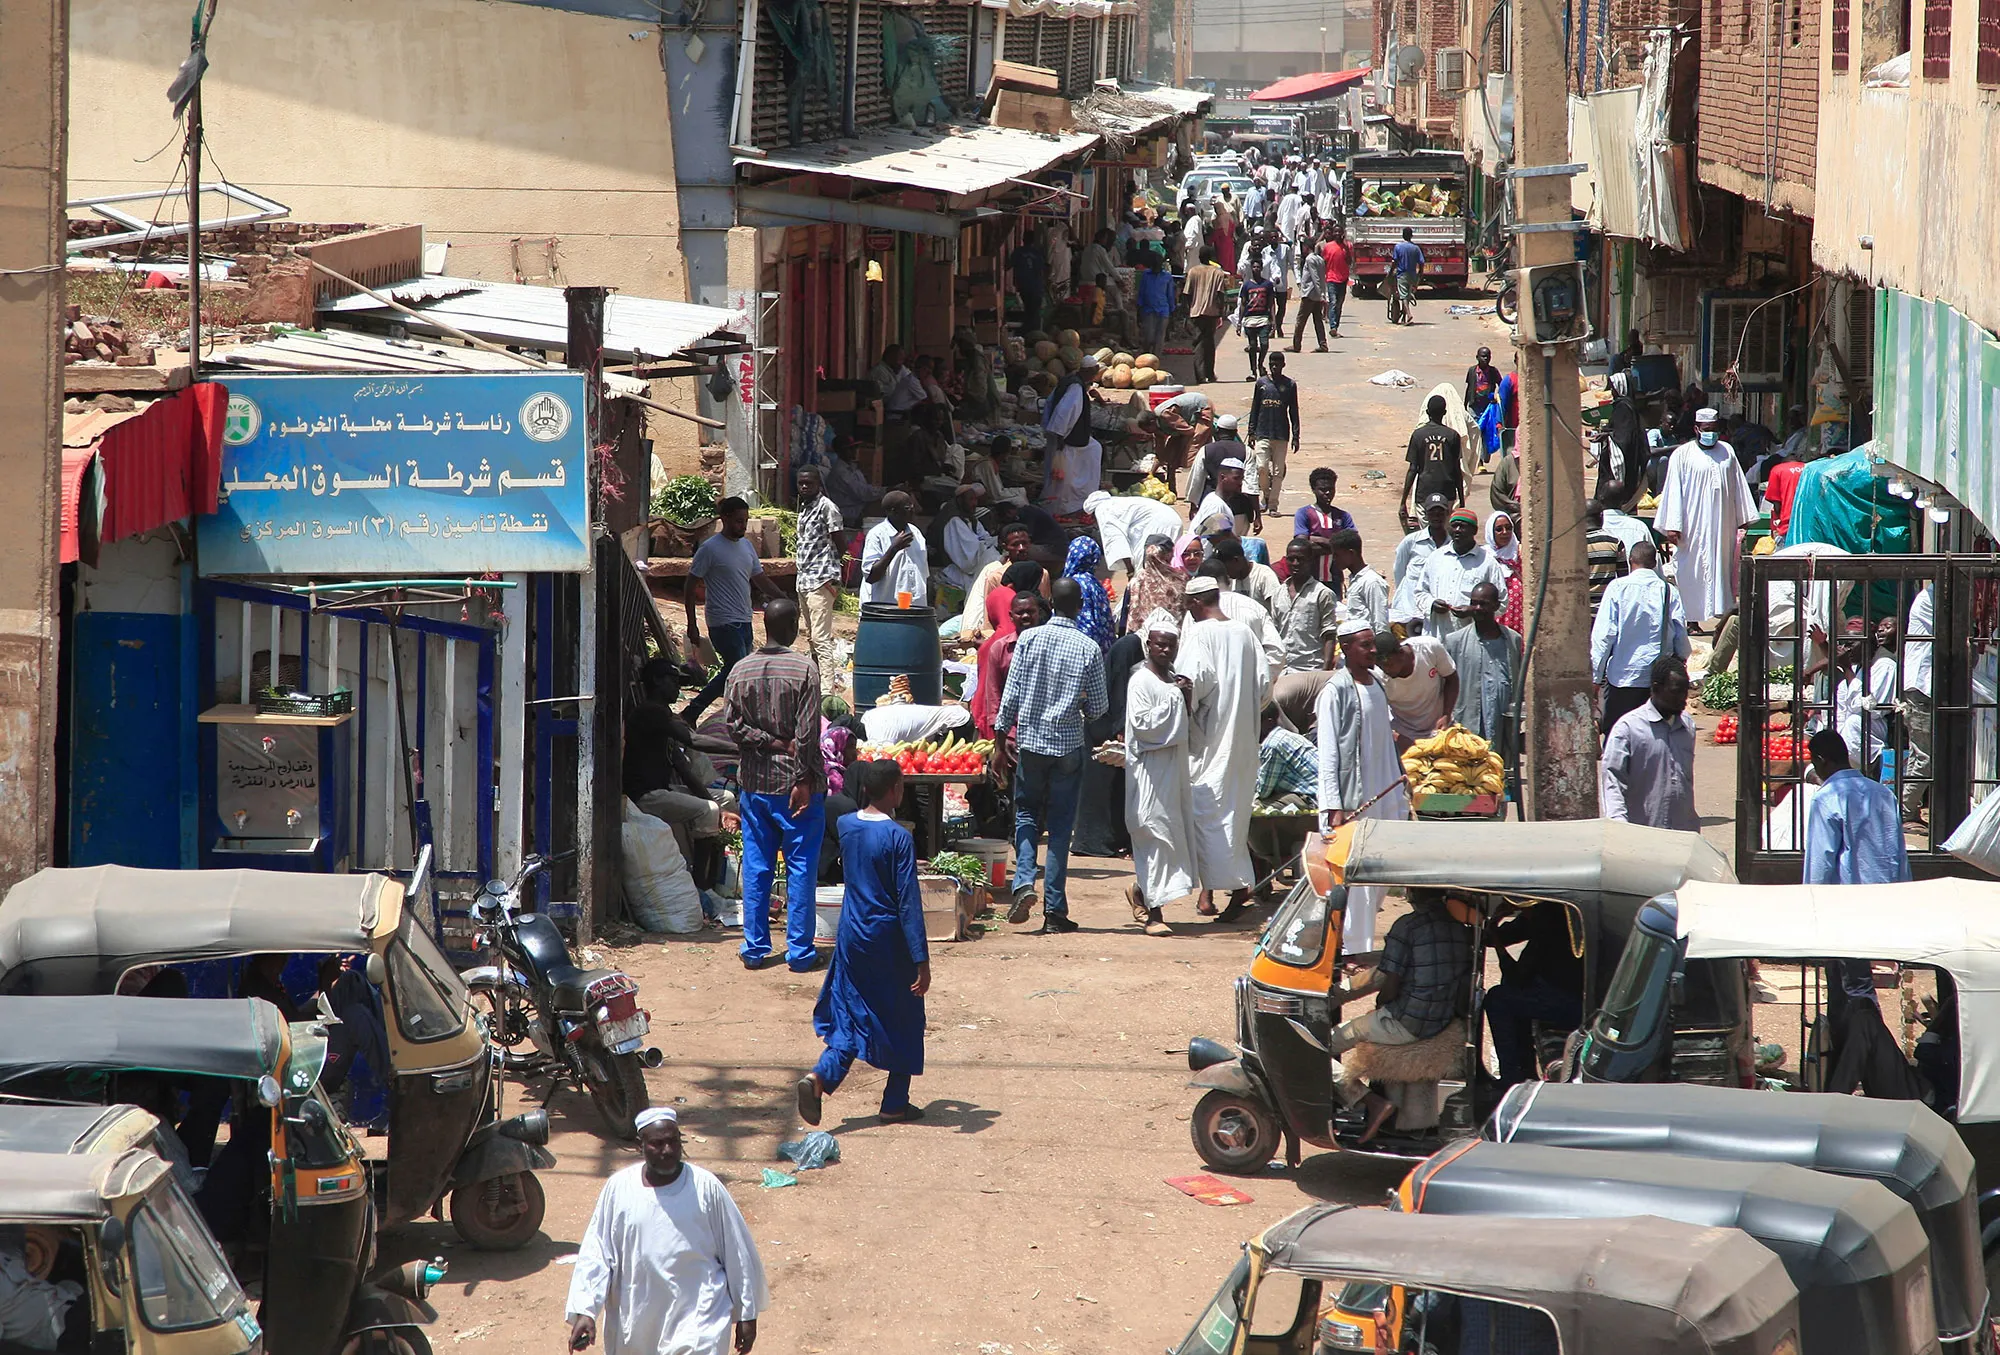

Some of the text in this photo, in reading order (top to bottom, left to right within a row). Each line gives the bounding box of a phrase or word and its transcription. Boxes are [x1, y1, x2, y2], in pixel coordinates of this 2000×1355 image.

[269, 411, 511, 438] رئاسة شرطة محلية الخرطوم
[1429, 443, 1443, 461] 21
[218, 458, 566, 504] قسم شرطة السوق المحلي
[240, 520, 307, 543] المركزي
[311, 520, 358, 539] السوق
[399, 512, 439, 538] رقم
[442, 513, 496, 539] تأمين
[500, 512, 549, 533] نقطة
